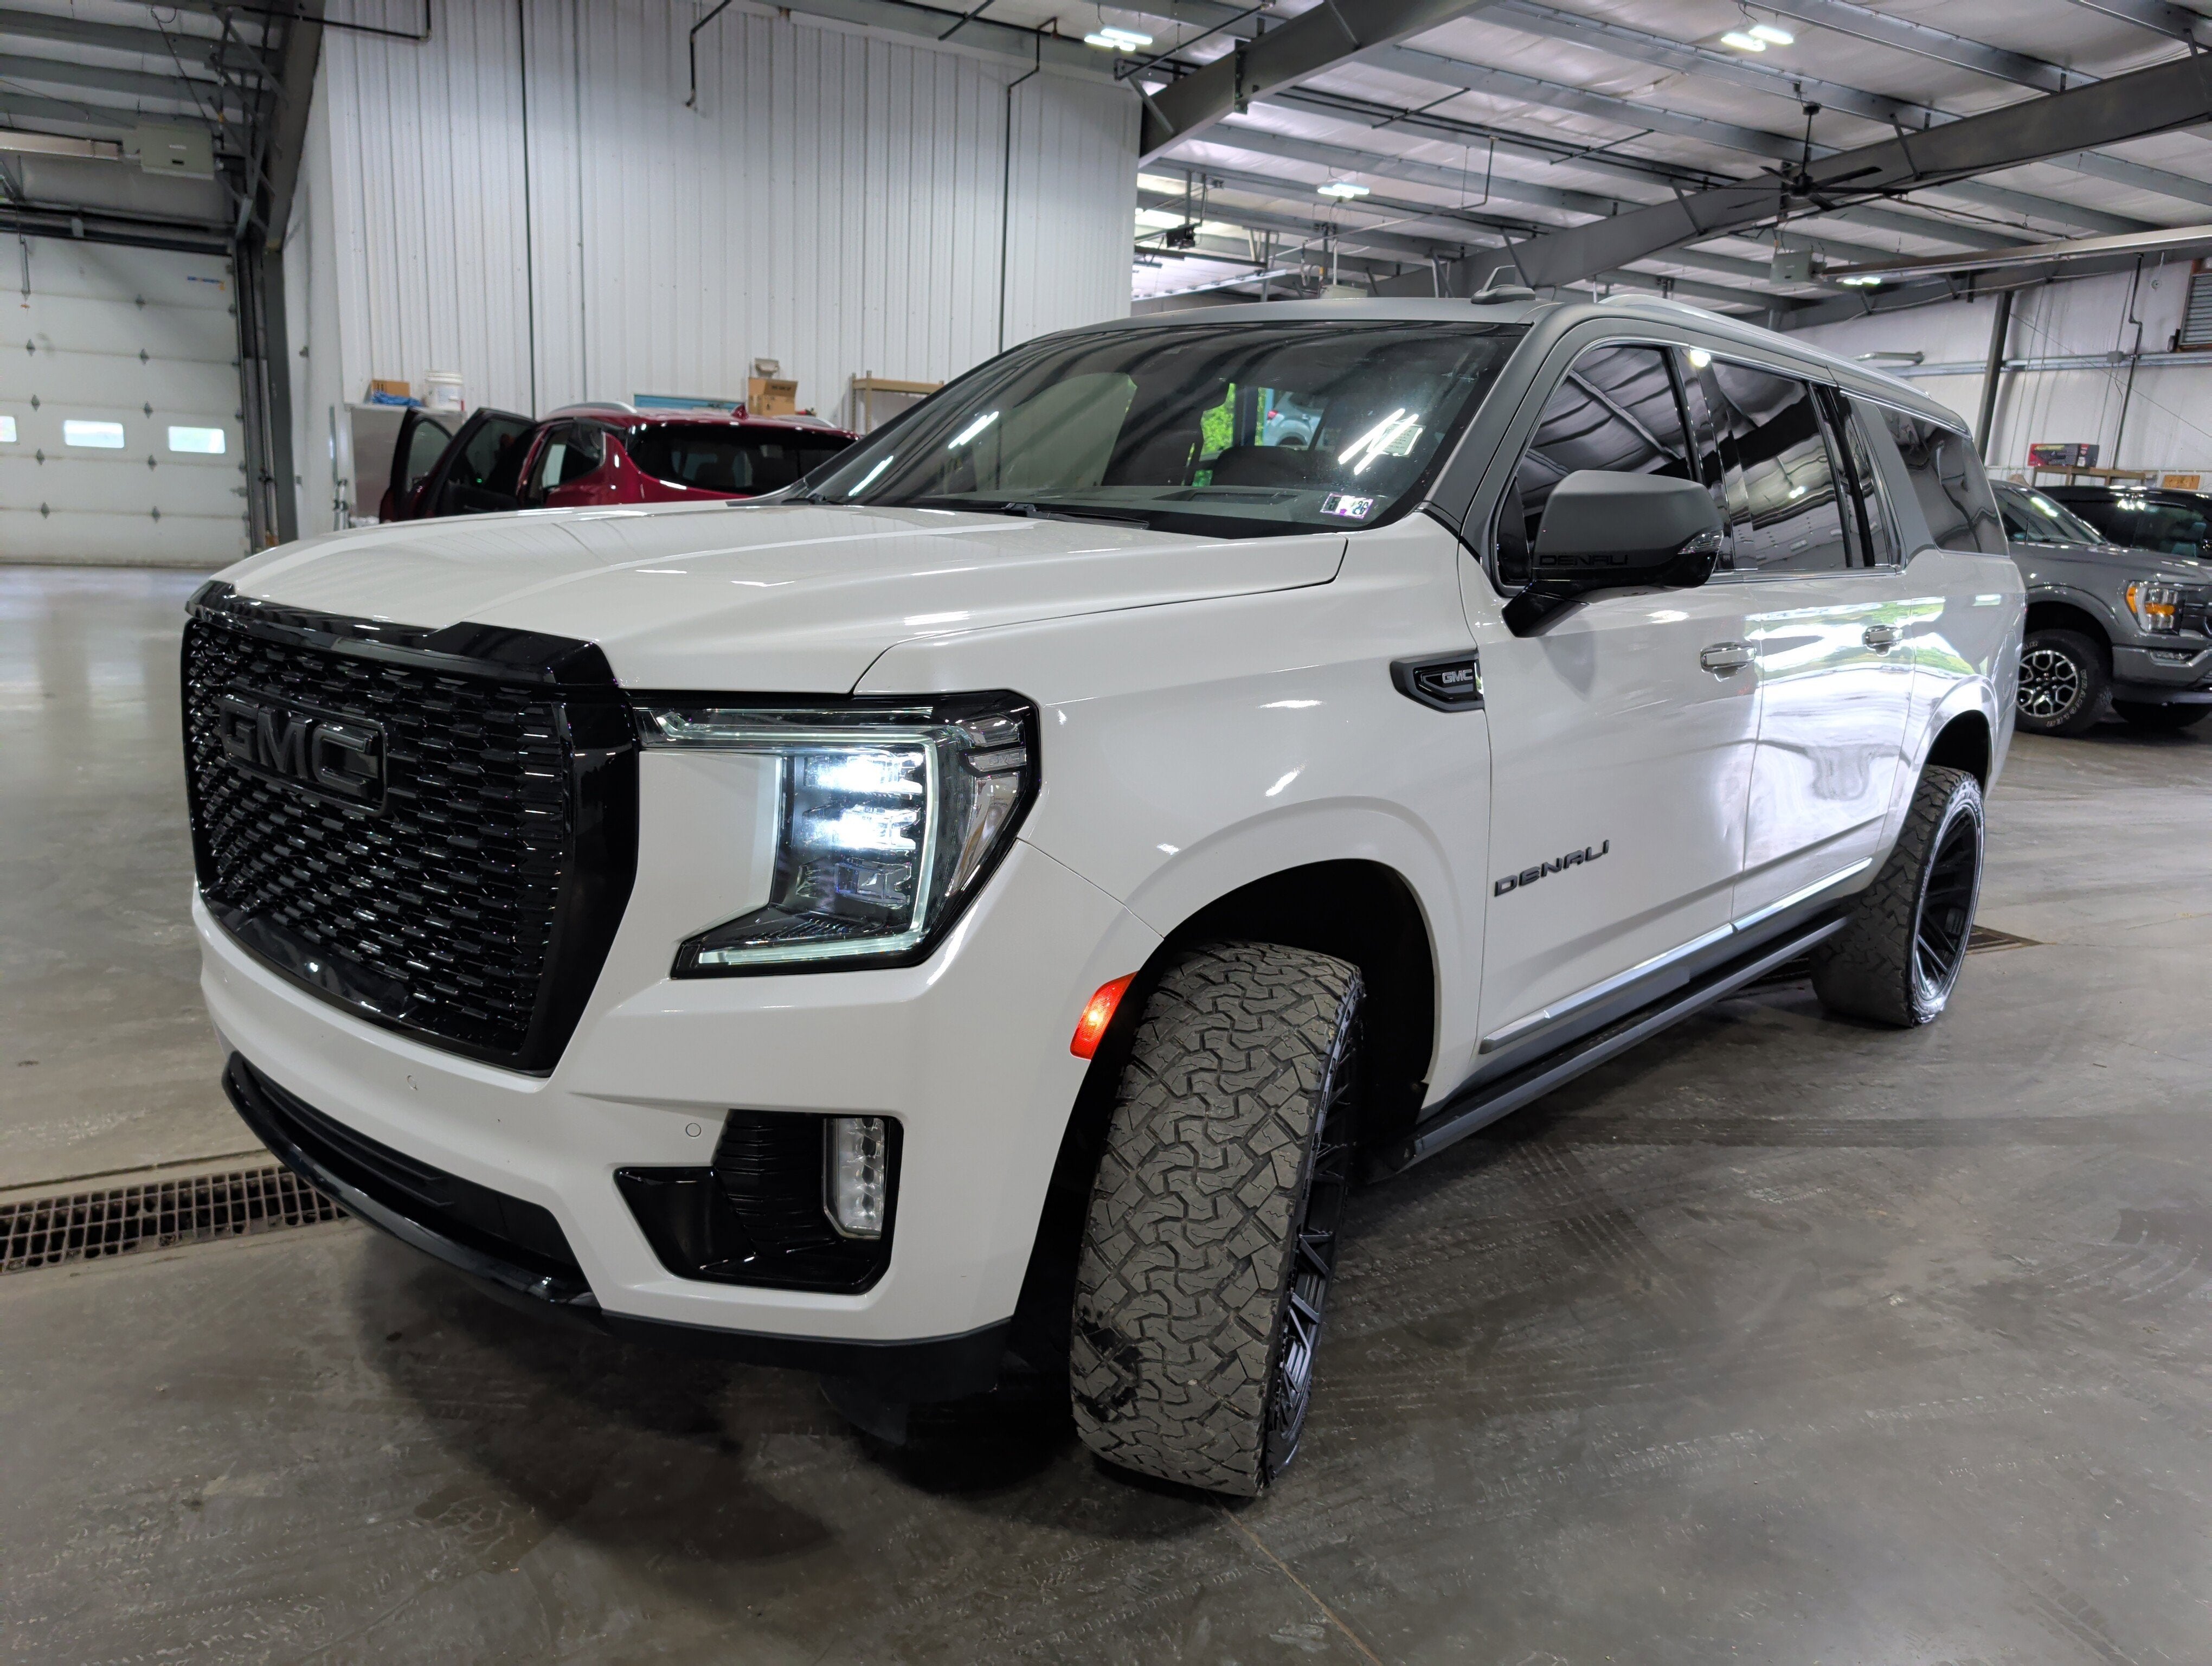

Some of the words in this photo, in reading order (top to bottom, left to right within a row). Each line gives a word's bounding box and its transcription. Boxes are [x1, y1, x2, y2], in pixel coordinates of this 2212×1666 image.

[1539, 554, 1628, 566] DENALI
[1442, 669, 1474, 684] GMC
[220, 694, 374, 799] GMC
[988, 752, 1020, 765] GMC
[1494, 839, 1610, 897] DENALI
